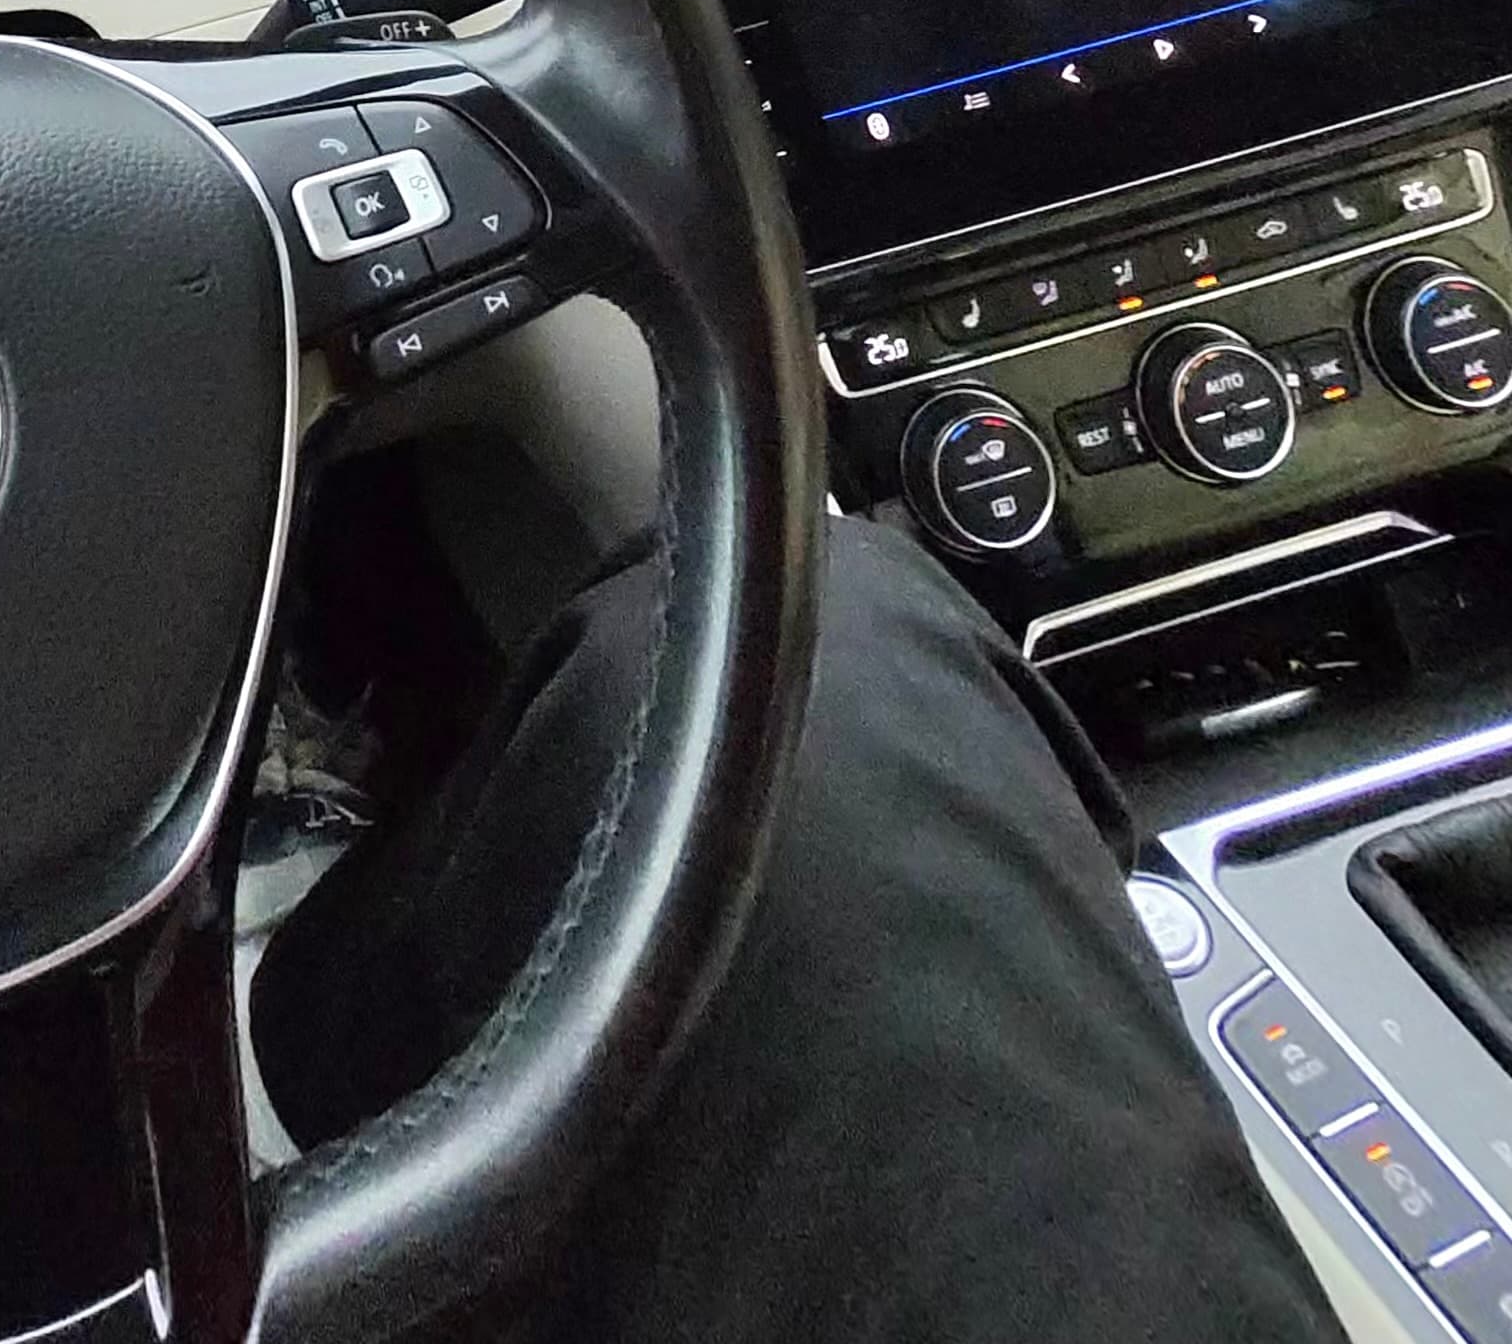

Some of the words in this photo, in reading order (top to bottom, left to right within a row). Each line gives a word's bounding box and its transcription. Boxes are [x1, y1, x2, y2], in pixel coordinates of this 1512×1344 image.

[355, 191, 386, 216] OK
[1310, 359, 1342, 381] SYNC
[1205, 372, 1244, 396] AUTO
[1077, 426, 1110, 448] REST
[1222, 427, 1265, 450] MENU
